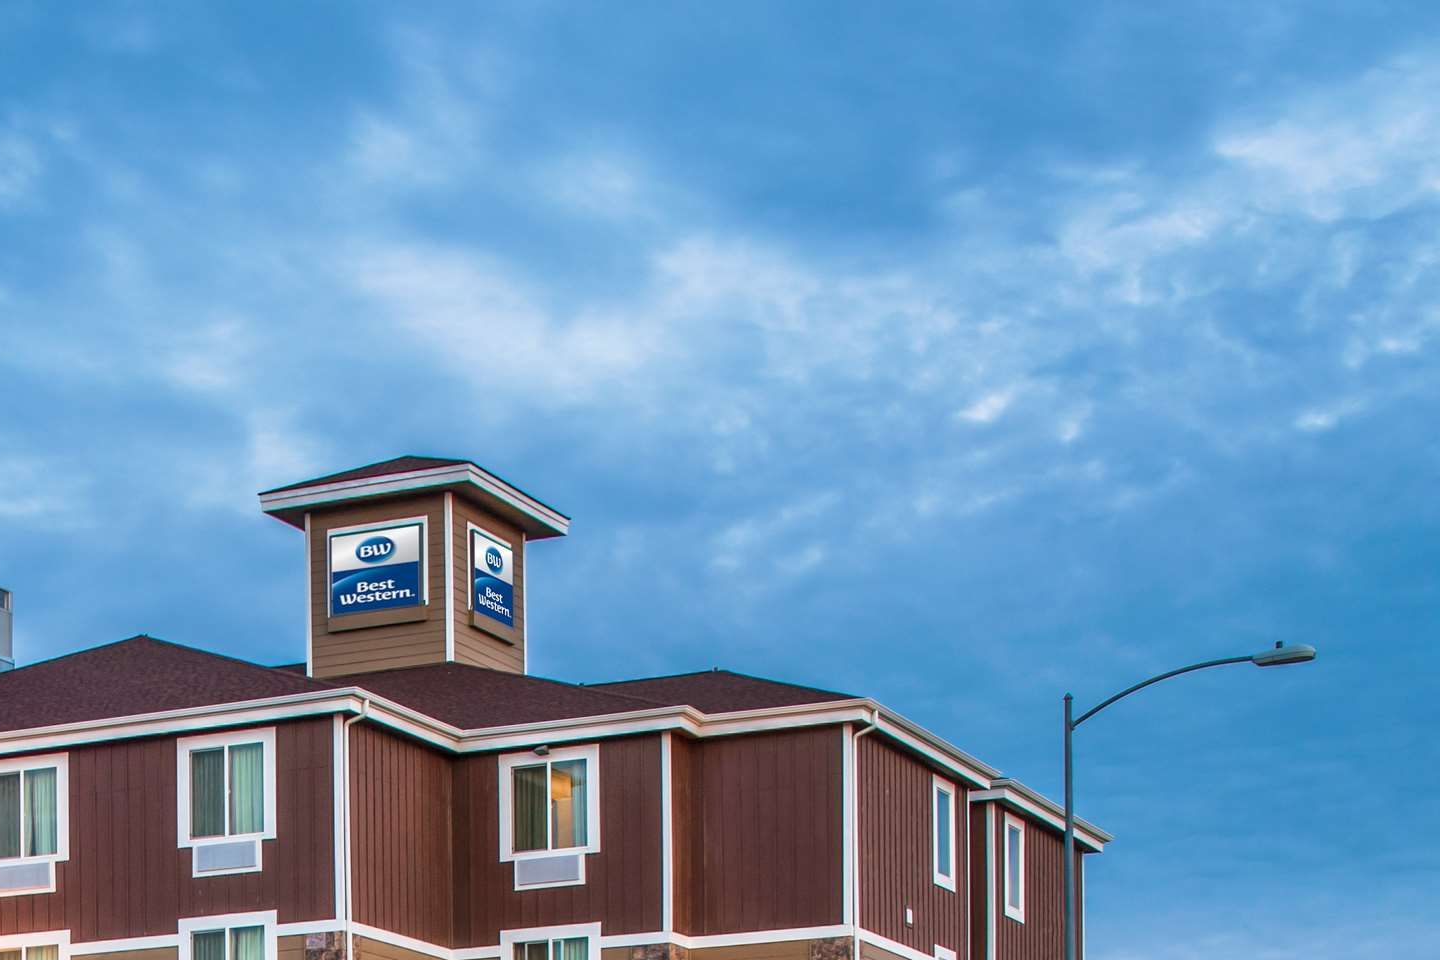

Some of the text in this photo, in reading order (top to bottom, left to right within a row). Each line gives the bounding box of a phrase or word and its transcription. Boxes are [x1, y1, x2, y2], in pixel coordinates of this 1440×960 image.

[359, 542, 392, 559] BW
[486, 551, 502, 569] BW
[356, 579, 396, 594] Best
[485, 586, 504, 604] Best
